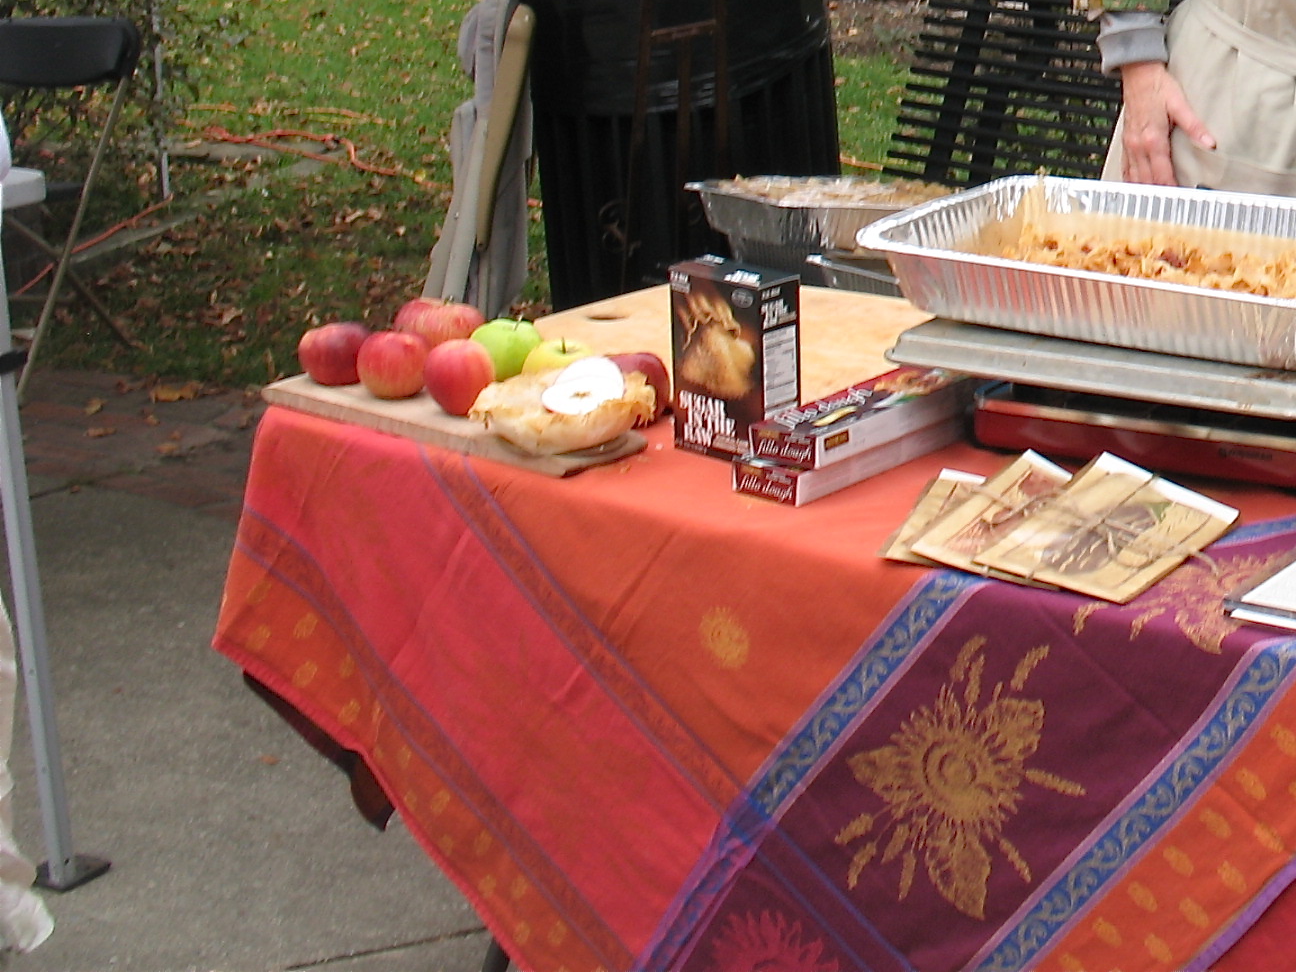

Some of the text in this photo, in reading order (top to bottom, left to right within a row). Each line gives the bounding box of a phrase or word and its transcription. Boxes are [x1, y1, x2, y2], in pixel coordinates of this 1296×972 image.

[679, 389, 726, 419] SUGAR
[684, 422, 713, 447] RAW
[758, 437, 779, 458] fillo
[780, 442, 812, 463] dough
[740, 474, 761, 494] fillo
[761, 480, 794, 502] dough
